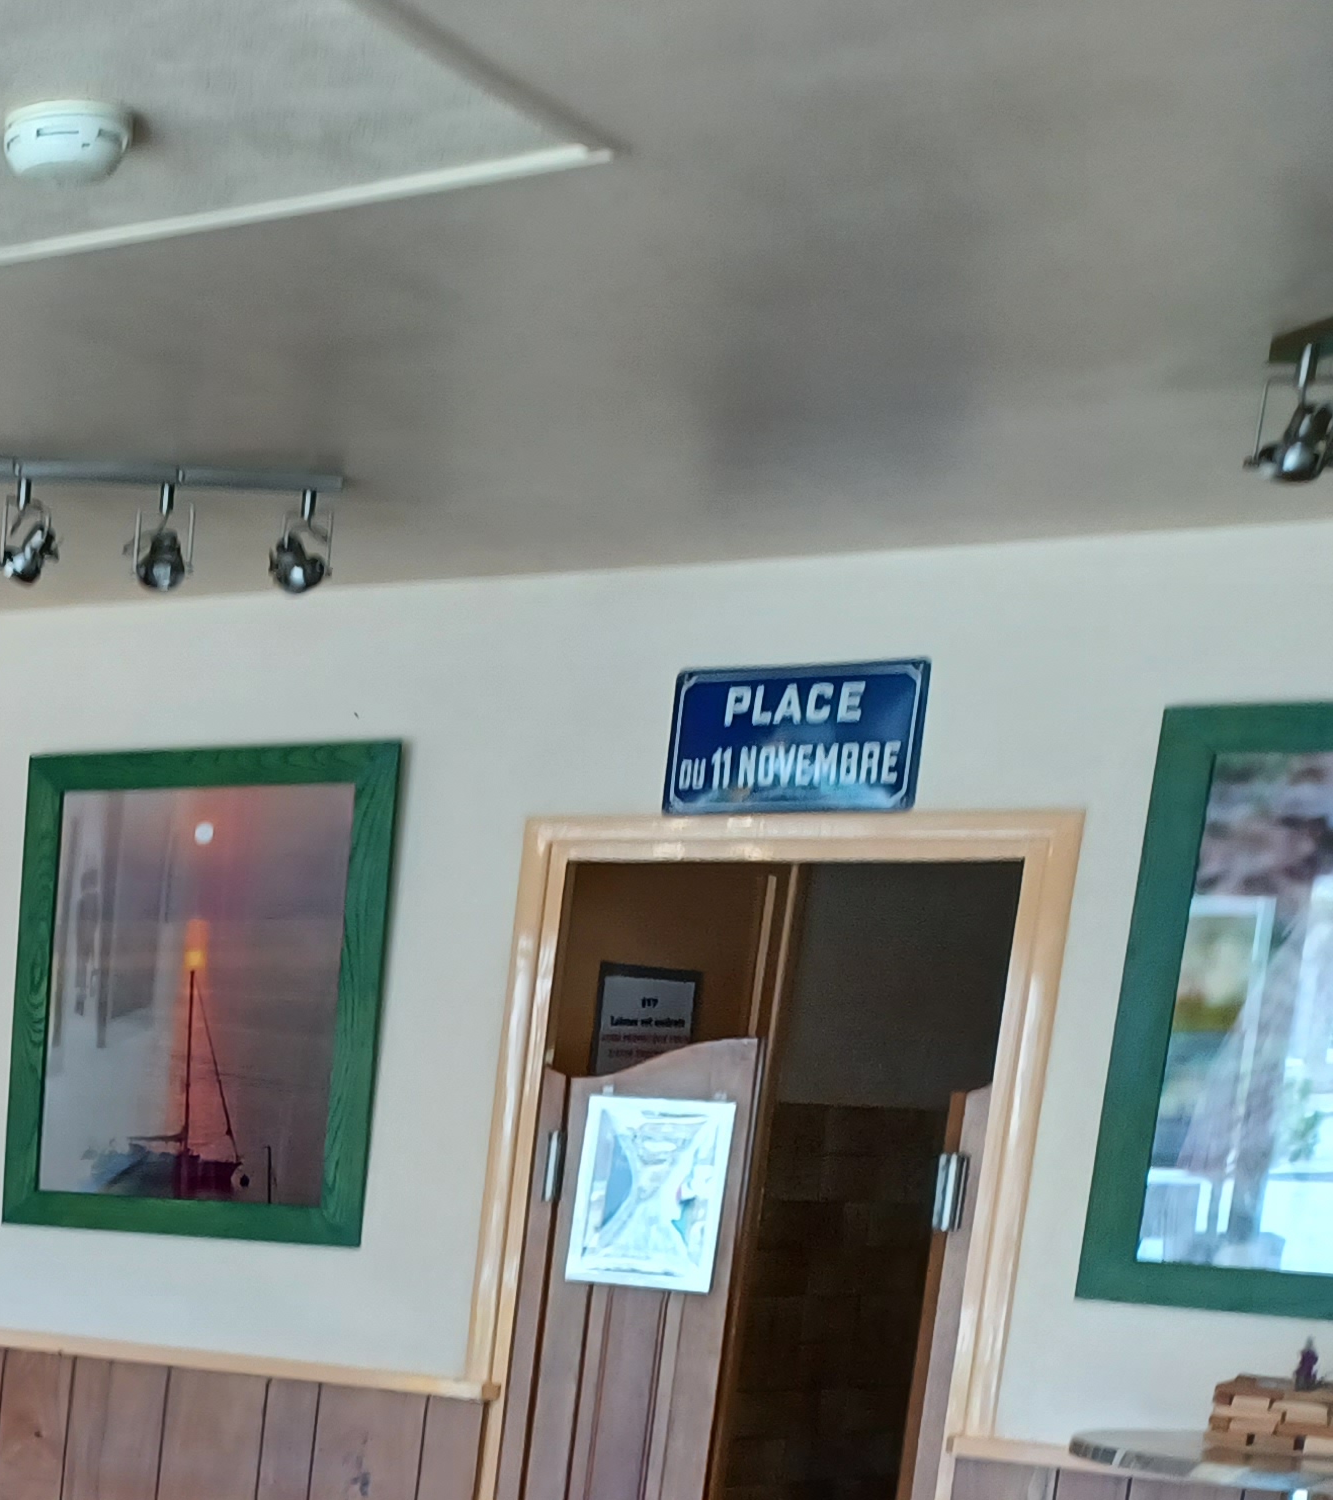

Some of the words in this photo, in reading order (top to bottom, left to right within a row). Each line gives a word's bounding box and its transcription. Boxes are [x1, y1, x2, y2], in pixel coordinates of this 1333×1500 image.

[724, 680, 866, 728] PLACE
[678, 757, 706, 790] DU
[711, 746, 733, 790] 11
[737, 740, 902, 788] NOVEMBRE
